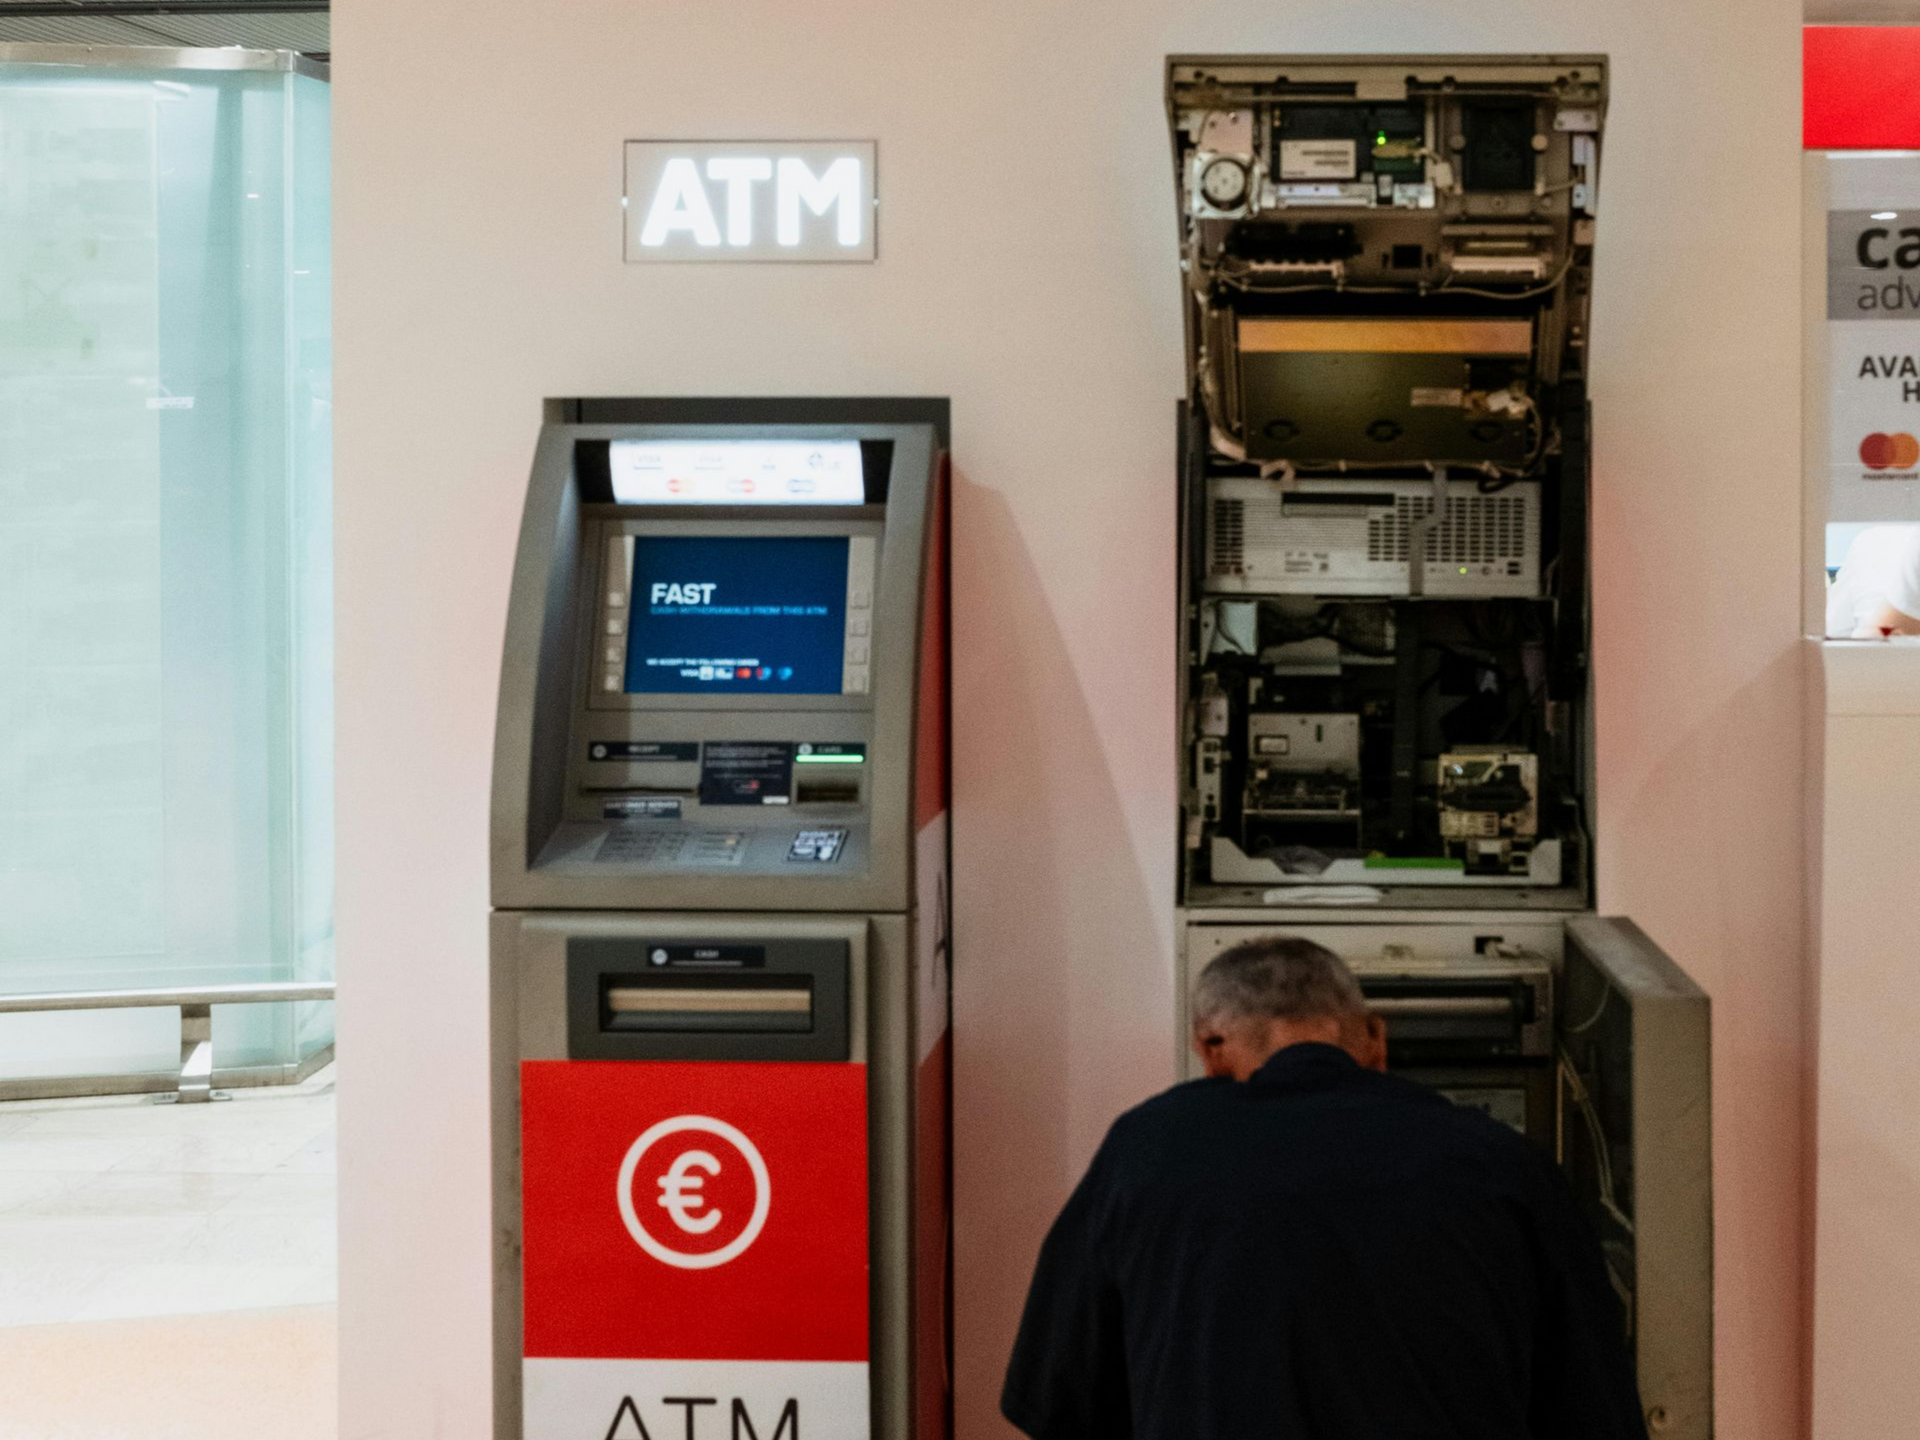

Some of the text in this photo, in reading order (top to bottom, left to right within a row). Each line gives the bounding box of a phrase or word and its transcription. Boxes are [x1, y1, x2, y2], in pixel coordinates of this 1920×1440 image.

[640, 157, 861, 246] ATM
[1857, 227, 1920, 269] ca
[1857, 275, 1920, 310] adv
[650, 583, 716, 605] FAST
[752, 606, 781, 616] FROM
[783, 606, 804, 616] THIS
[806, 606, 828, 616] ATM
[603, 1395, 798, 1440] ATM
